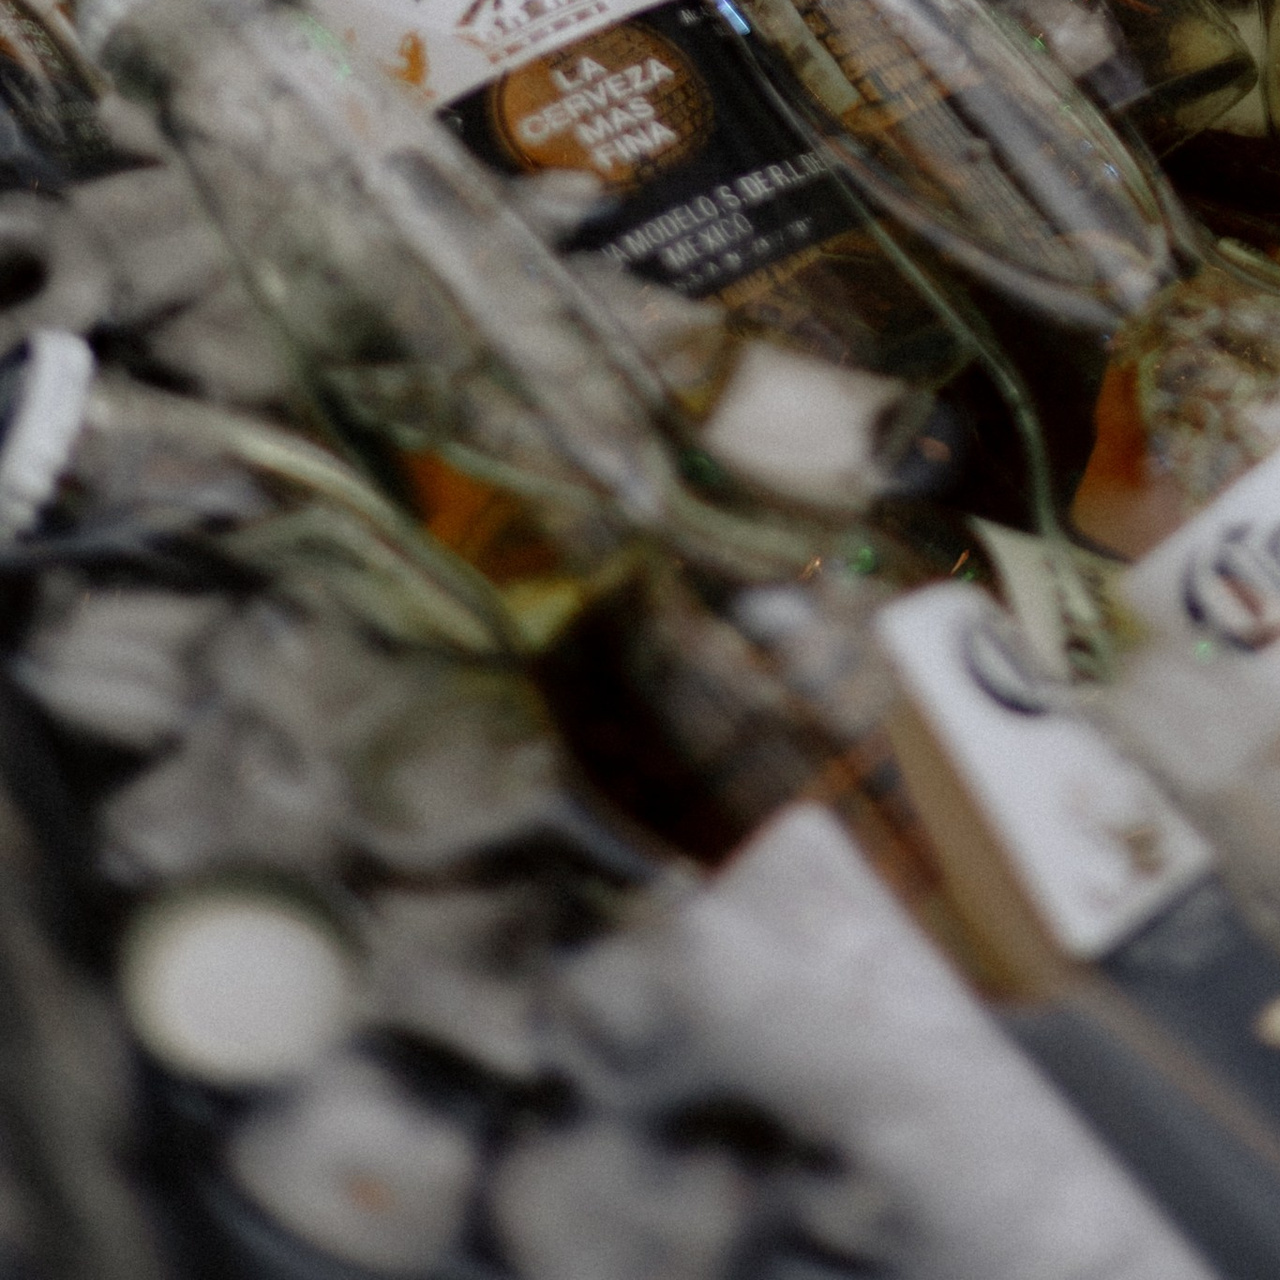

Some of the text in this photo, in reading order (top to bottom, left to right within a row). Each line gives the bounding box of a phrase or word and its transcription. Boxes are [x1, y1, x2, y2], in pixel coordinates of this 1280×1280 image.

[551, 55, 607, 93] LA
[518, 57, 676, 146] CERVEZA
[574, 95, 656, 147] MAS
[592, 120, 677, 174] FINA
